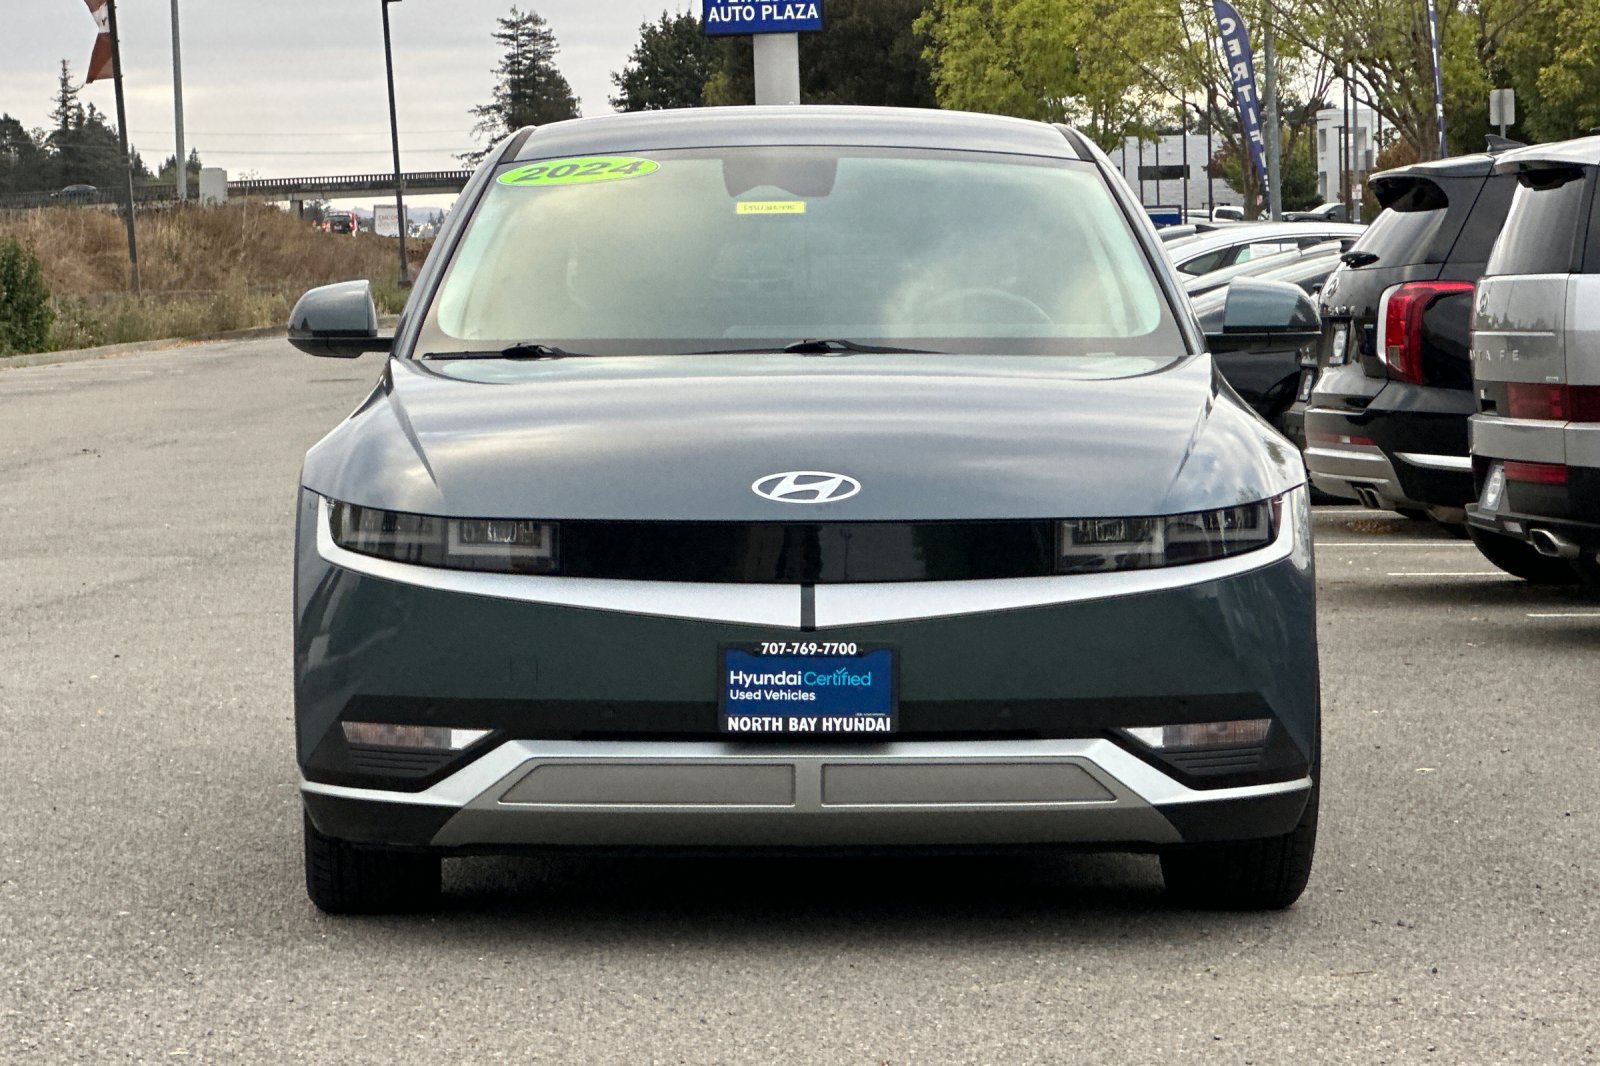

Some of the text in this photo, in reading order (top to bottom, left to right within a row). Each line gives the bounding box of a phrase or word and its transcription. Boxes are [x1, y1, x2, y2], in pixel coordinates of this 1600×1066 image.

[708, 3, 819, 22] AUTO PLAZA
[512, 161, 641, 183] 2024
[761, 642, 857, 655] 707-769-7700
[730, 667, 871, 688] Hyundai Certified
[730, 689, 816, 701] Used Vehicles
[728, 717, 891, 731] NORTH BAY HYUNDAI
